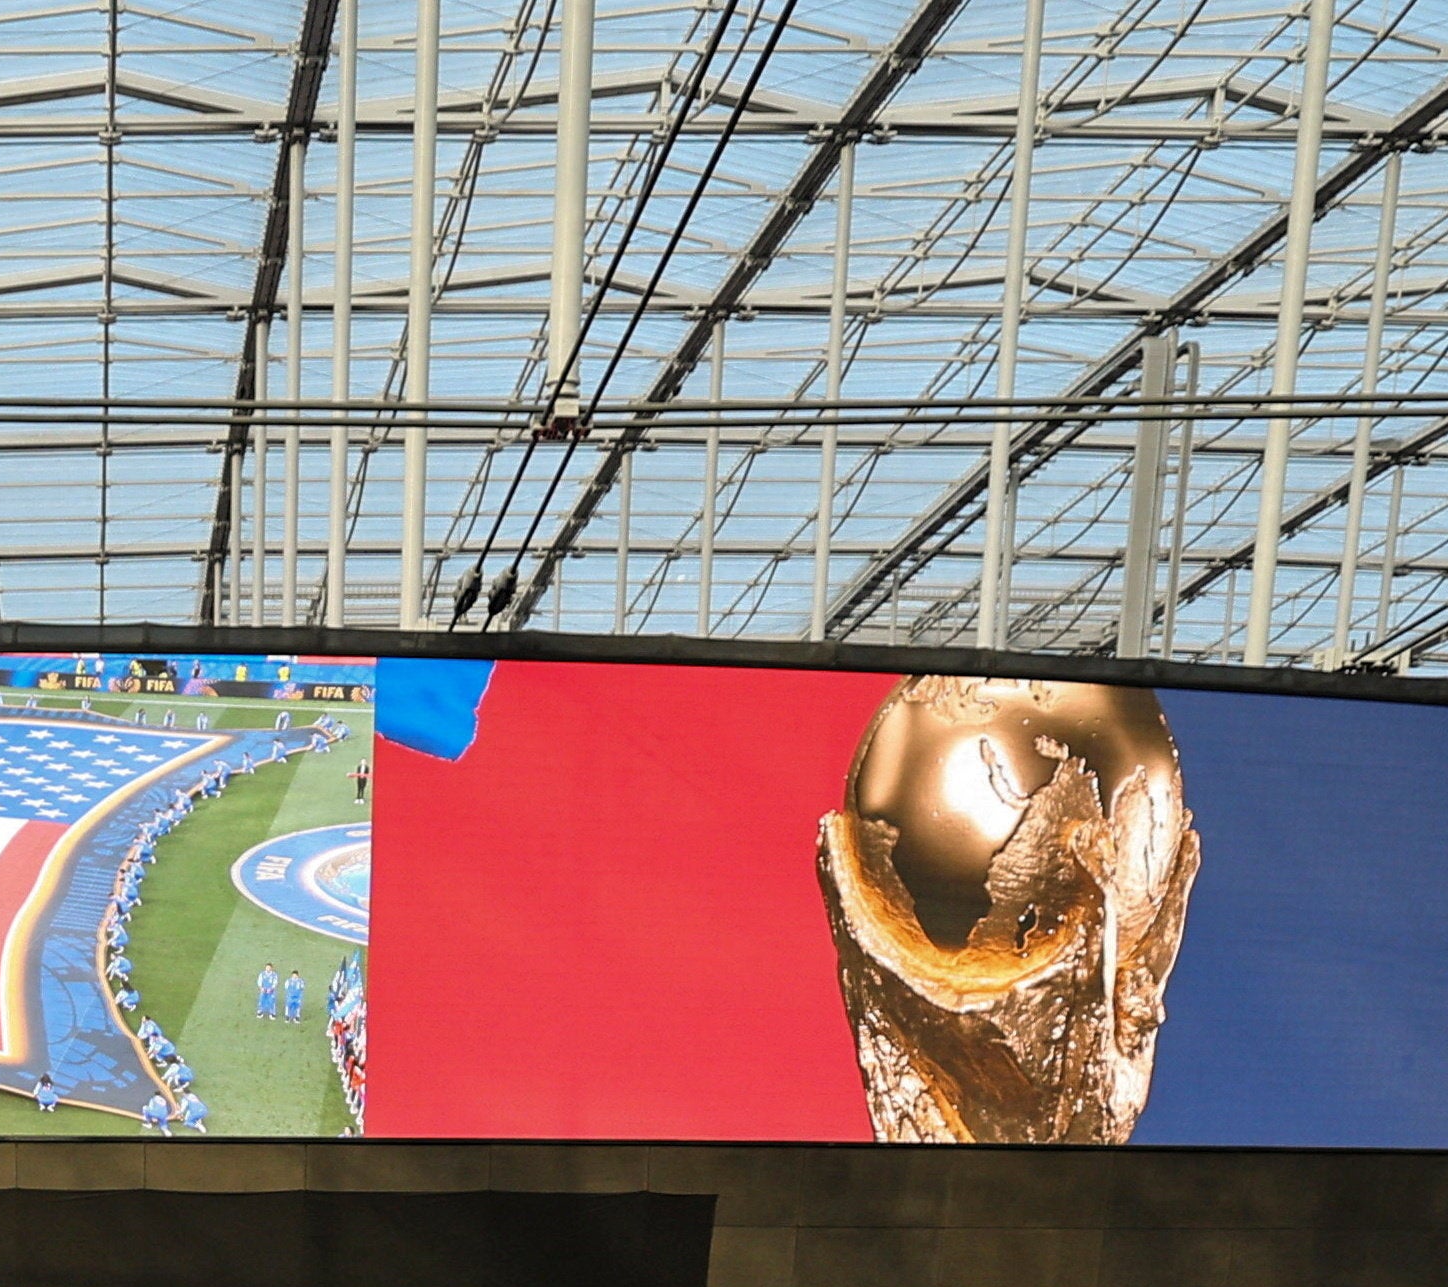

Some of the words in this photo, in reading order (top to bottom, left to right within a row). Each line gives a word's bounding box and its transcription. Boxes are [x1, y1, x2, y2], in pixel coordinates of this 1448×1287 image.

[75, 676, 101, 689] FIFA
[147, 679, 174, 692] FIFA
[314, 686, 344, 699] FIFA
[255, 855, 293, 882] FIFA
